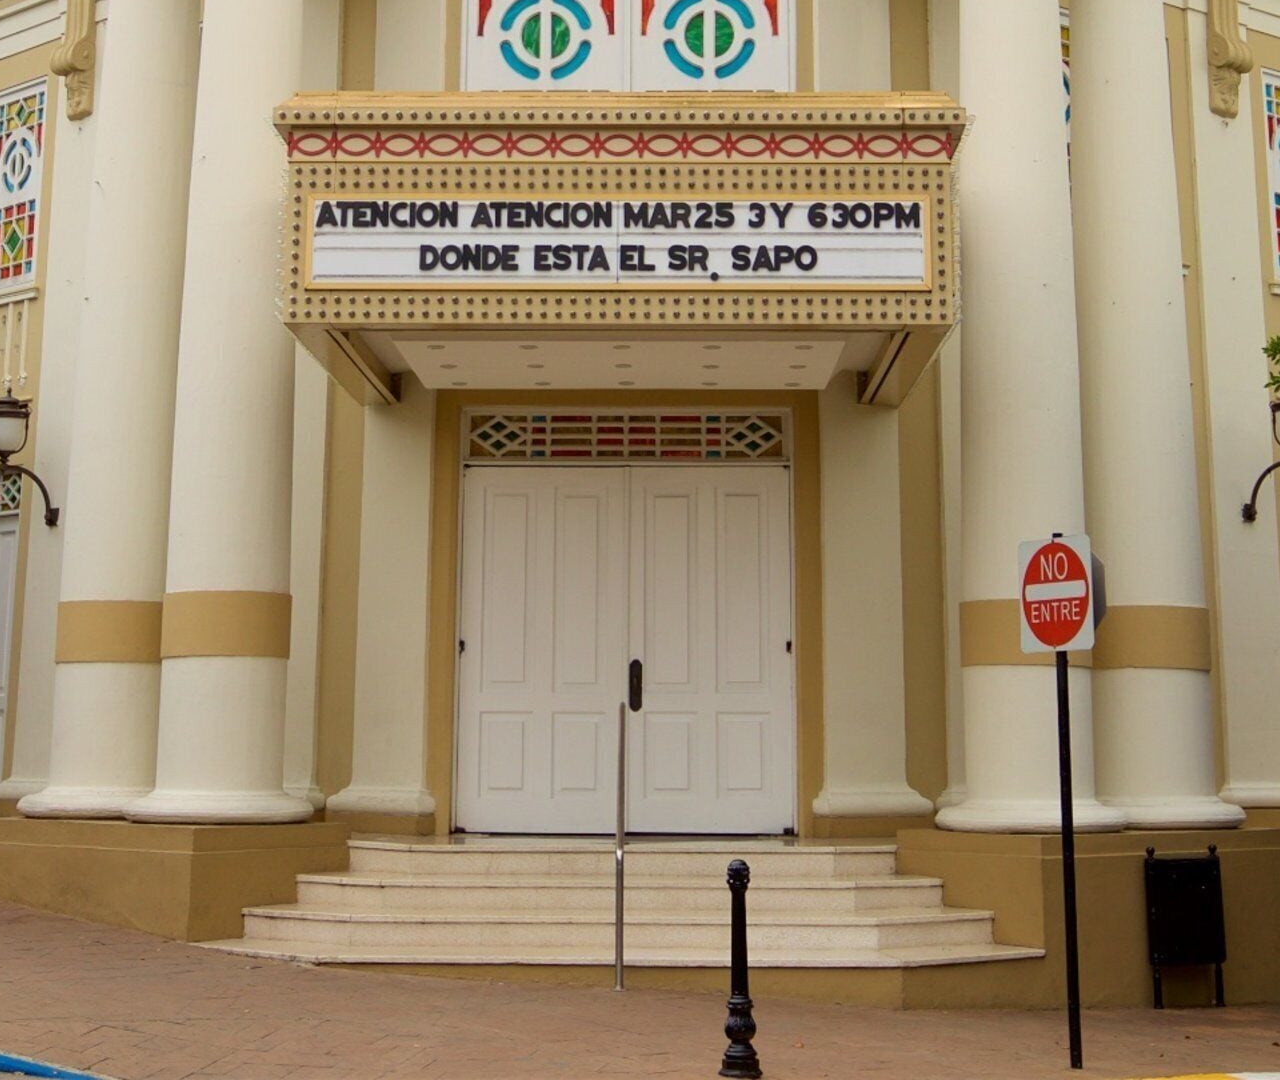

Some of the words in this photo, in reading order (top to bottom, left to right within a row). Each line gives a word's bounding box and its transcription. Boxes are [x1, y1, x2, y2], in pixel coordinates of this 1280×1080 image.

[316, 201, 458, 228] ATENCION
[471, 202, 612, 228] ATENCION
[419, 244, 519, 271] DONDE
[534, 245, 610, 271] ESTA
[620, 245, 656, 271] EL
[731, 245, 818, 271] SAPO
[1039, 552, 1069, 581] NO
[1030, 600, 1081, 623] ENTRE
